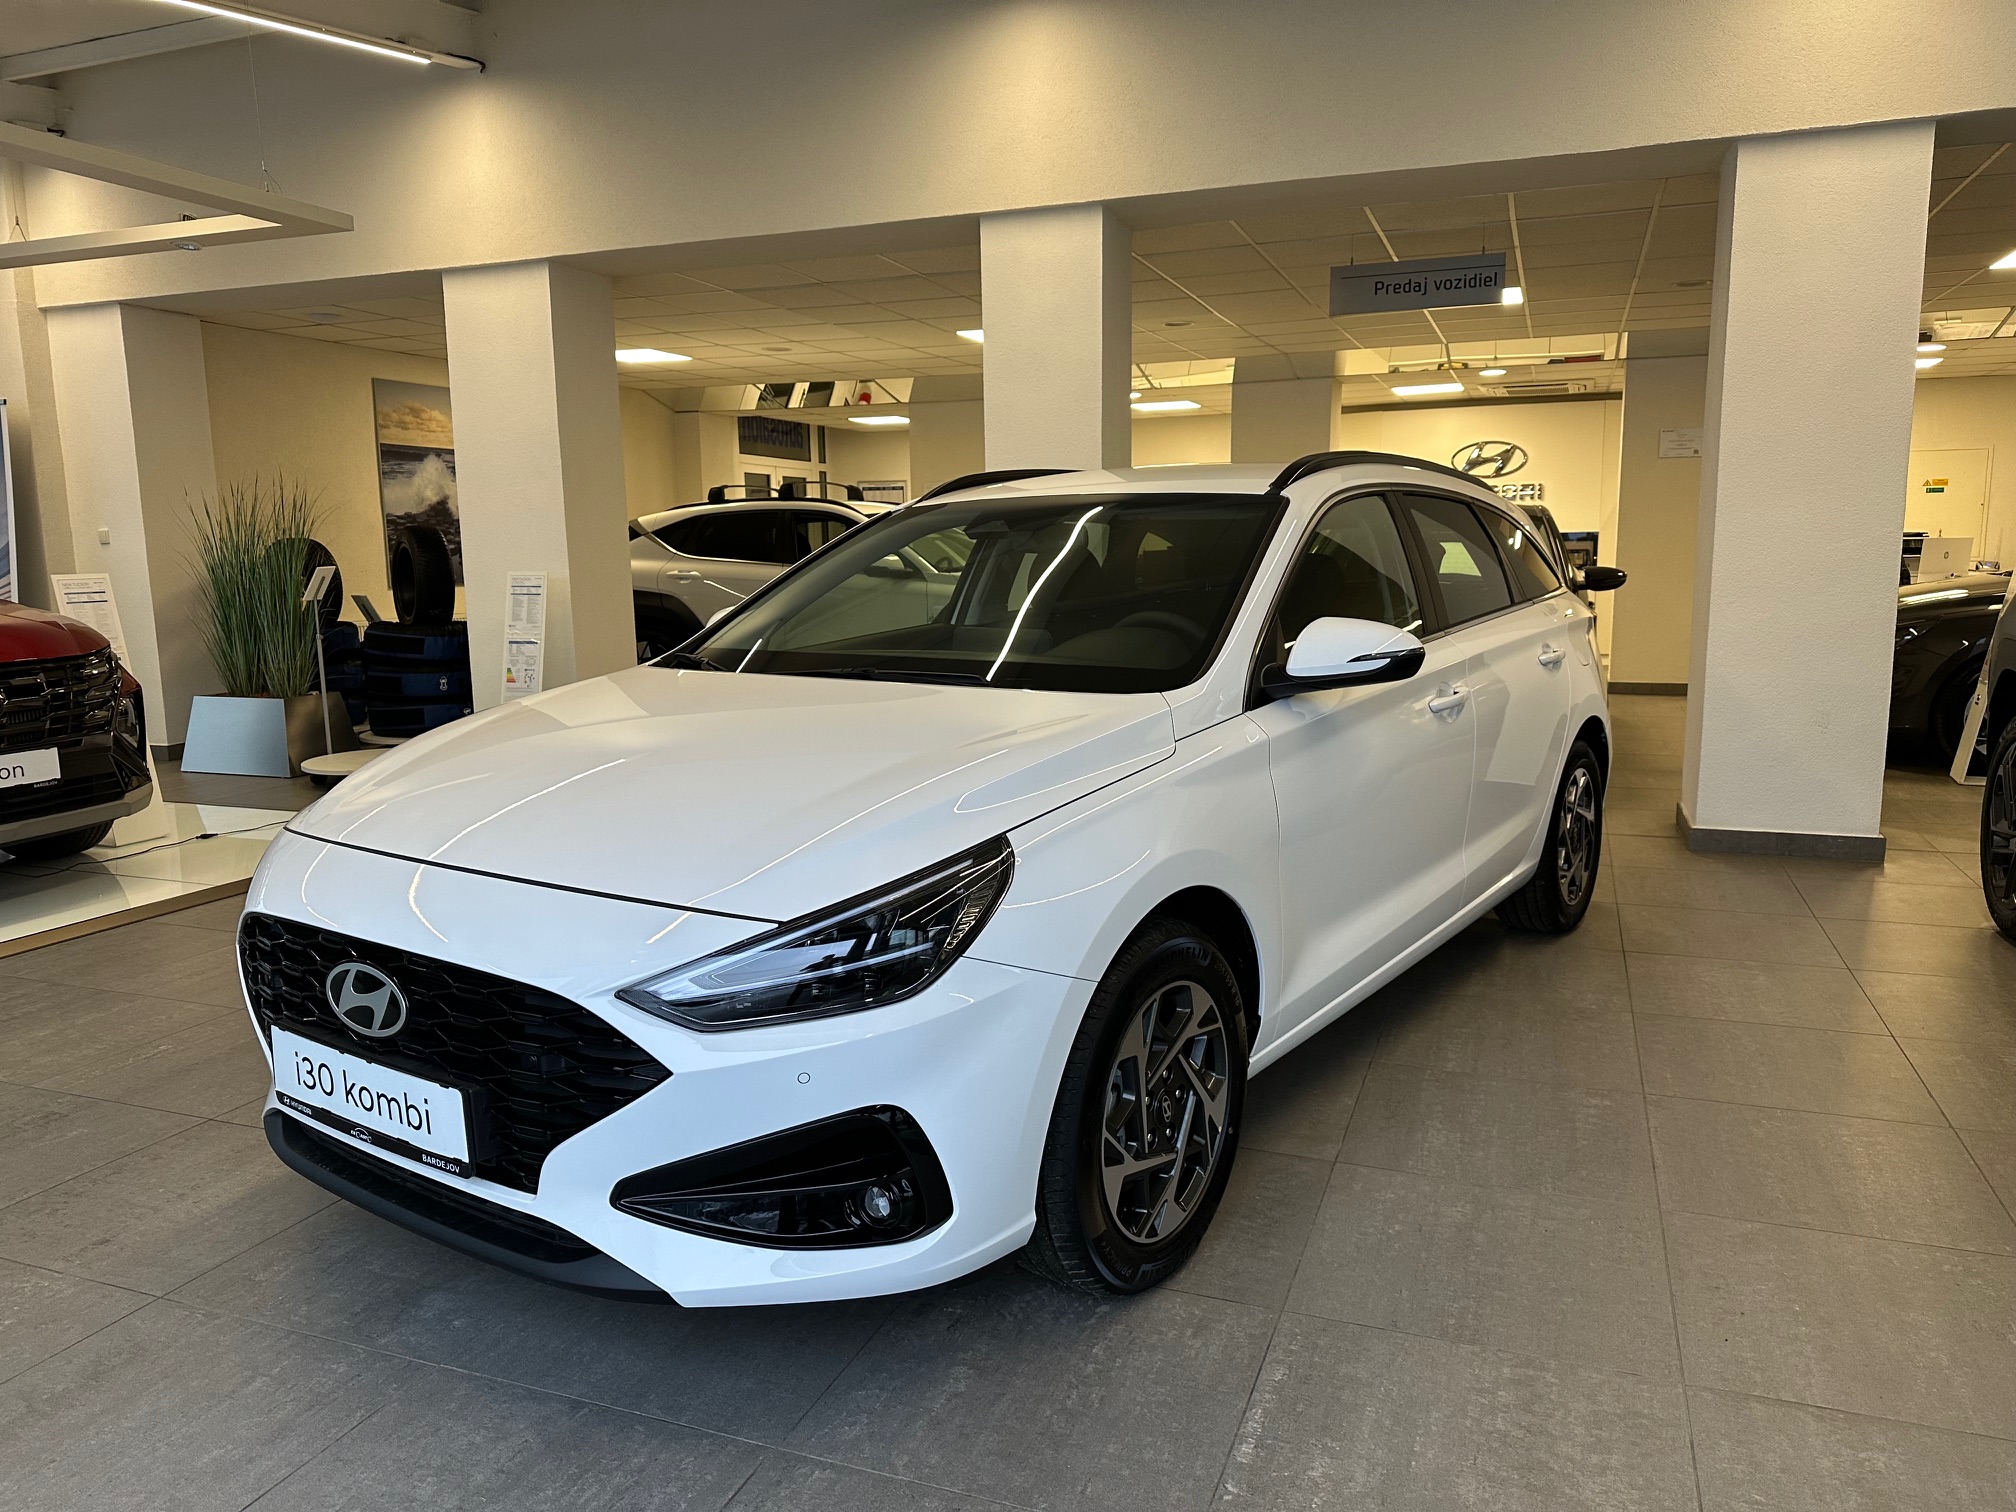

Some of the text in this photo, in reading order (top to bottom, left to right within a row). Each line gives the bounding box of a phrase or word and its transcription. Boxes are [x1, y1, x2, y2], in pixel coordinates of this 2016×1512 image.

[1374, 272, 1498, 296] Predaj vozidiel
[294, 1050, 432, 1135] i30 kombi
[422, 1153, 460, 1174] BARDEJOV
